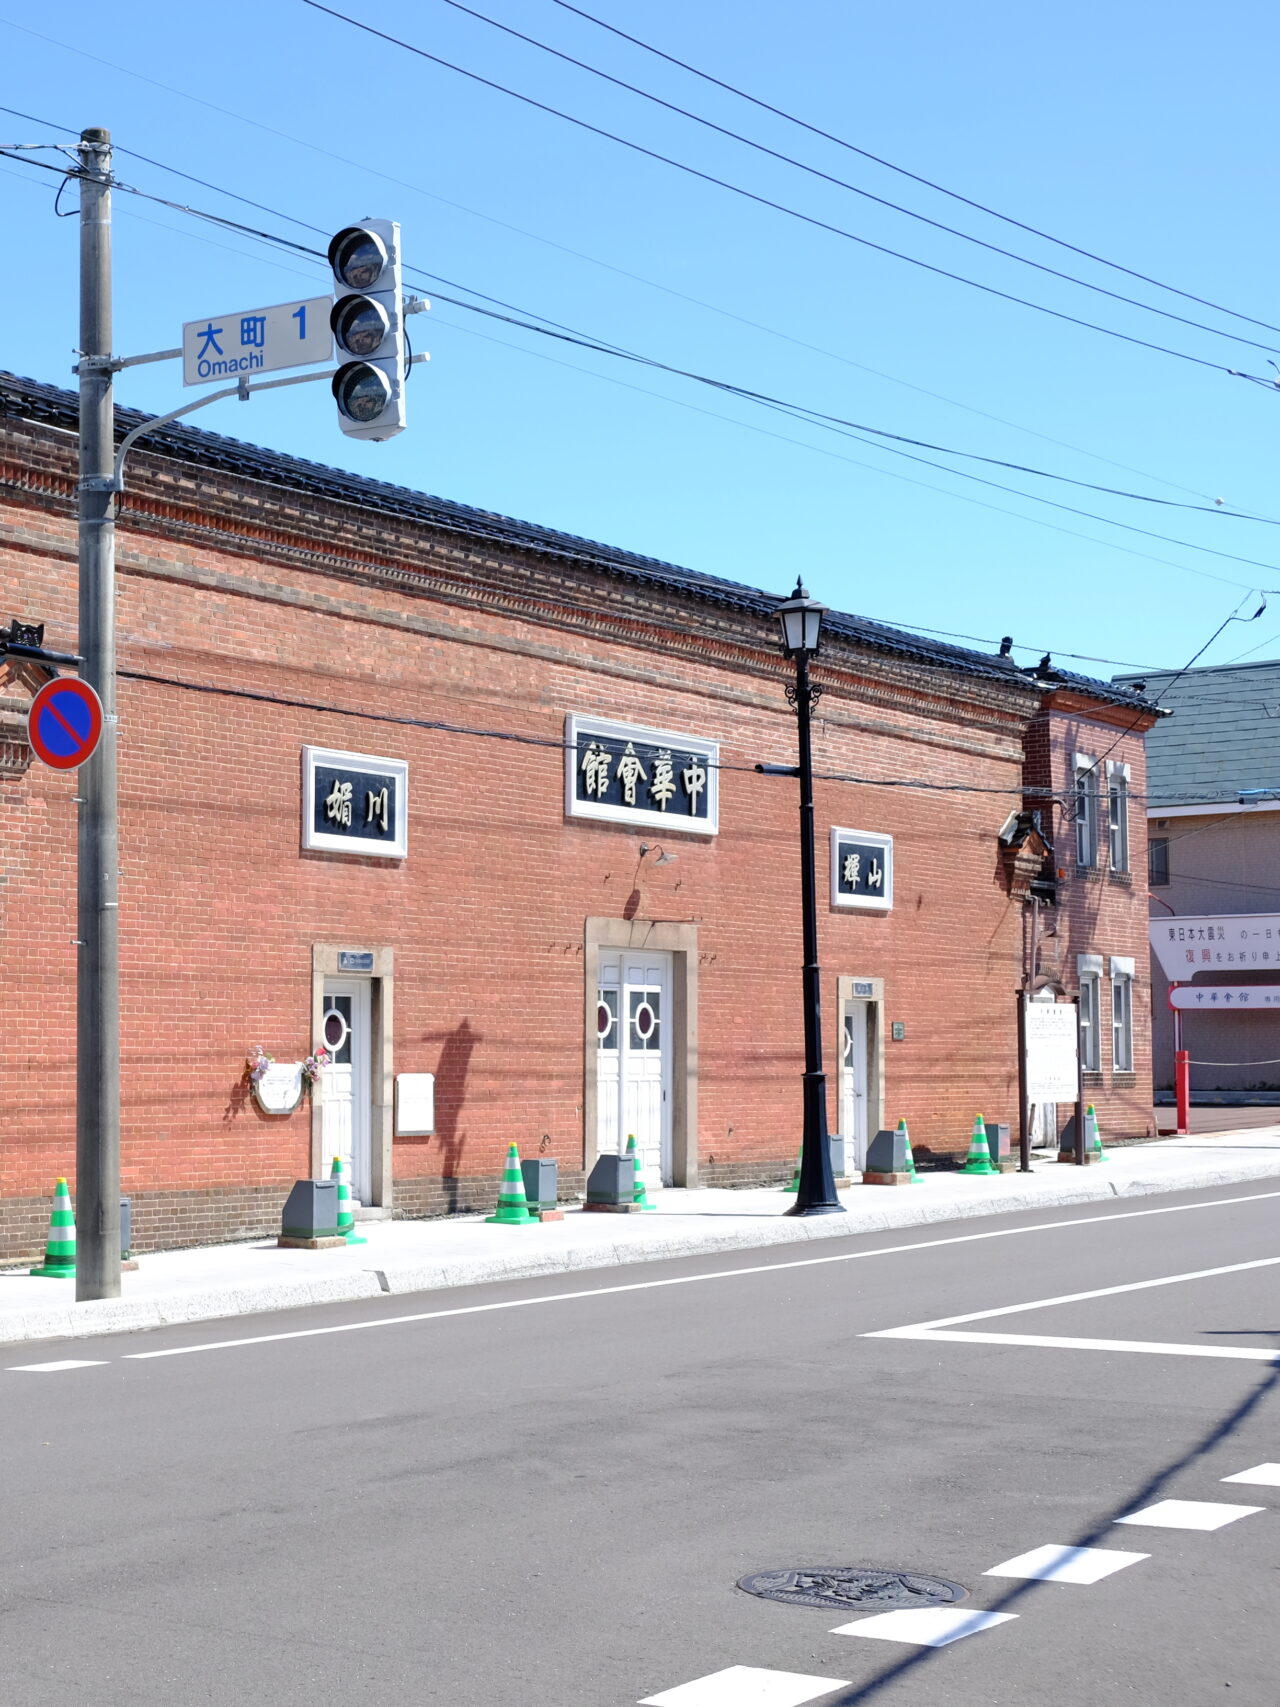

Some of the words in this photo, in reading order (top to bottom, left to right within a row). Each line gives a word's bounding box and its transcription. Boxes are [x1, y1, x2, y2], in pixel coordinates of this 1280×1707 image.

[197, 316, 266, 360] 大町
[292, 305, 307, 340] 1
[197, 350, 264, 378] Omachi
[1168, 926, 1225, 941] 東日本大震災
[1240, 928, 1280, 940] の一日
